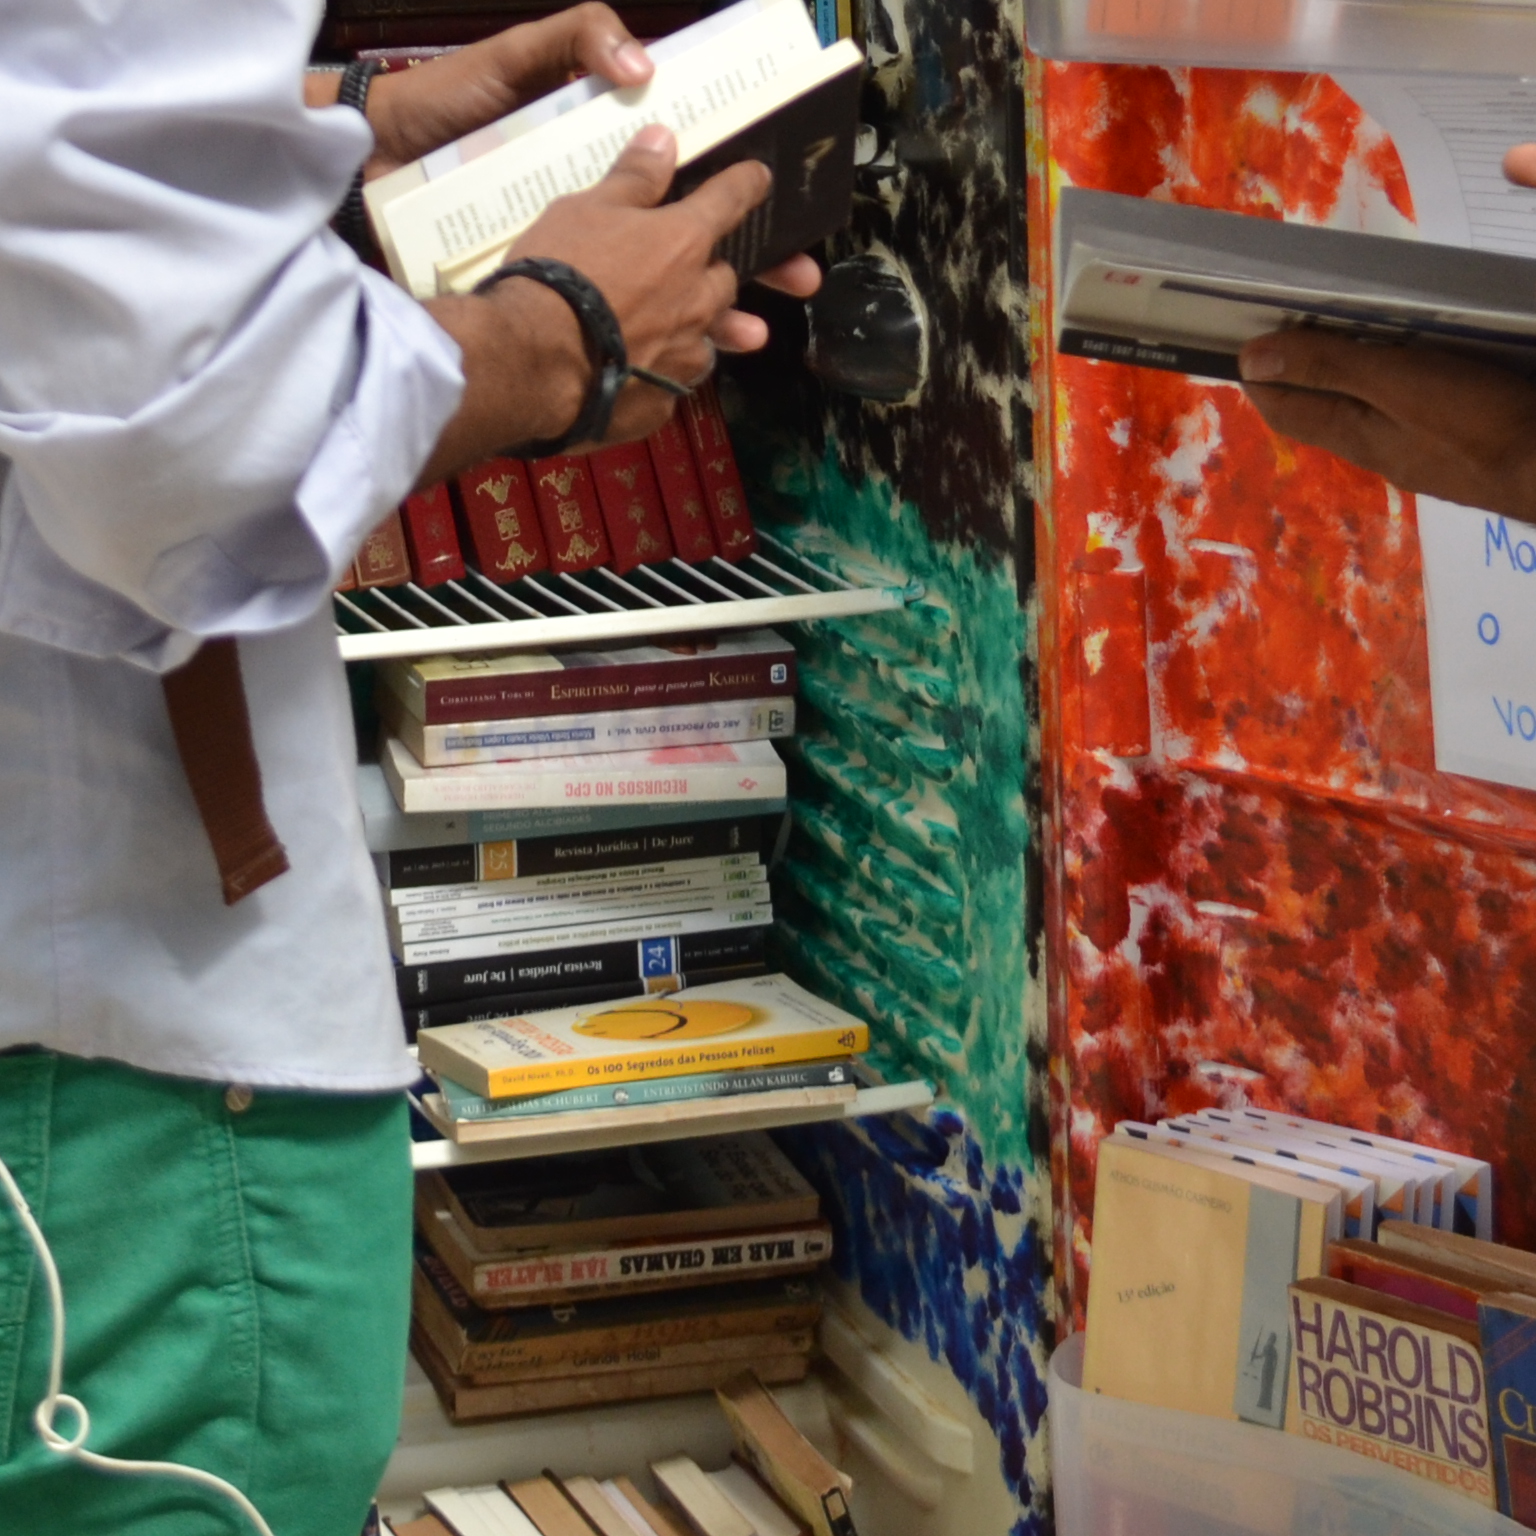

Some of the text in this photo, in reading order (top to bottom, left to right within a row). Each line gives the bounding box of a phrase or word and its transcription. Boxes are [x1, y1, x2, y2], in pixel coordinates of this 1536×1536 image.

[550, 682, 630, 701] ESPIRITISMO
[708, 670, 760, 688] KARDEC
[658, 722, 705, 733] PROCESSO
[706, 721, 721, 729] DO
[722, 719, 741, 728] ABC
[564, 777, 688, 798] RECURSOS NO CPC
[488, 846, 509, 872] 25
[554, 834, 695, 860] Revista Jurídica De Jure
[647, 944, 667, 971] 24
[463, 959, 603, 984] Revista Jurídica De Jure
[587, 1044, 776, 1076] Os 100 Segredos das Pessoas Felizes
[643, 1070, 809, 1099] ENTREVISTANDO ALLAN KARDEC
[541, 1091, 598, 1108] SCHUBERT
[619, 1249, 706, 1276] CHAMAS
[710, 1244, 745, 1264] EM
[748, 1238, 795, 1262] MAR
[486, 1260, 559, 1290] SLATER
[563, 1257, 609, 1283] IAN
[1136, 1281, 1177, 1302] edição
[572, 1345, 661, 1366] Grande Hotel
[1292, 1295, 1482, 1406] HAROLD
[1297, 1356, 1488, 1470] ROBBINS
[1302, 1419, 1491, 1498] OS PERVERTIDOS
